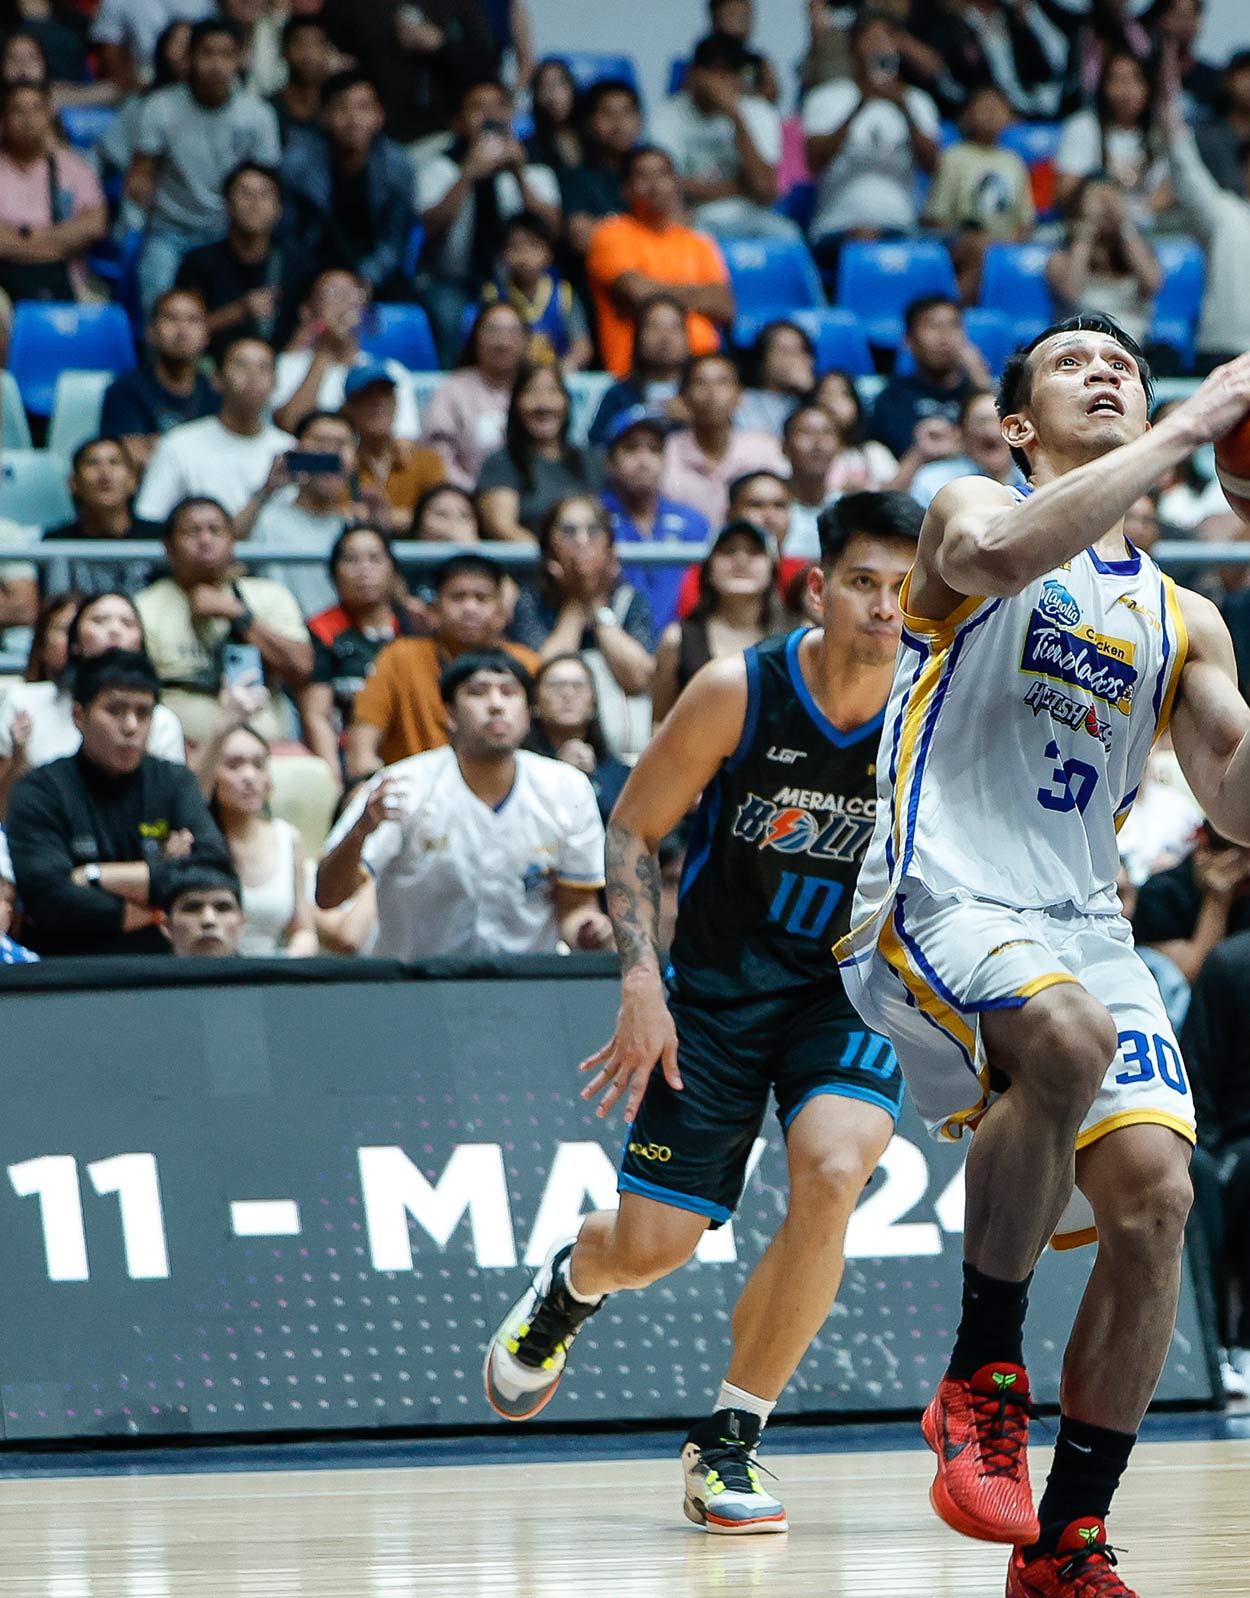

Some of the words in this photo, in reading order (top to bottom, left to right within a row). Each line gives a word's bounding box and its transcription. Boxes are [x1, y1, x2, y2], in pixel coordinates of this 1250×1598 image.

[1037, 740, 1099, 818] 30
[768, 870, 844, 939] 10
[839, 1031, 899, 1080] 10
[1115, 1029, 1188, 1096] 30
[7, 1152, 171, 1281] 11
